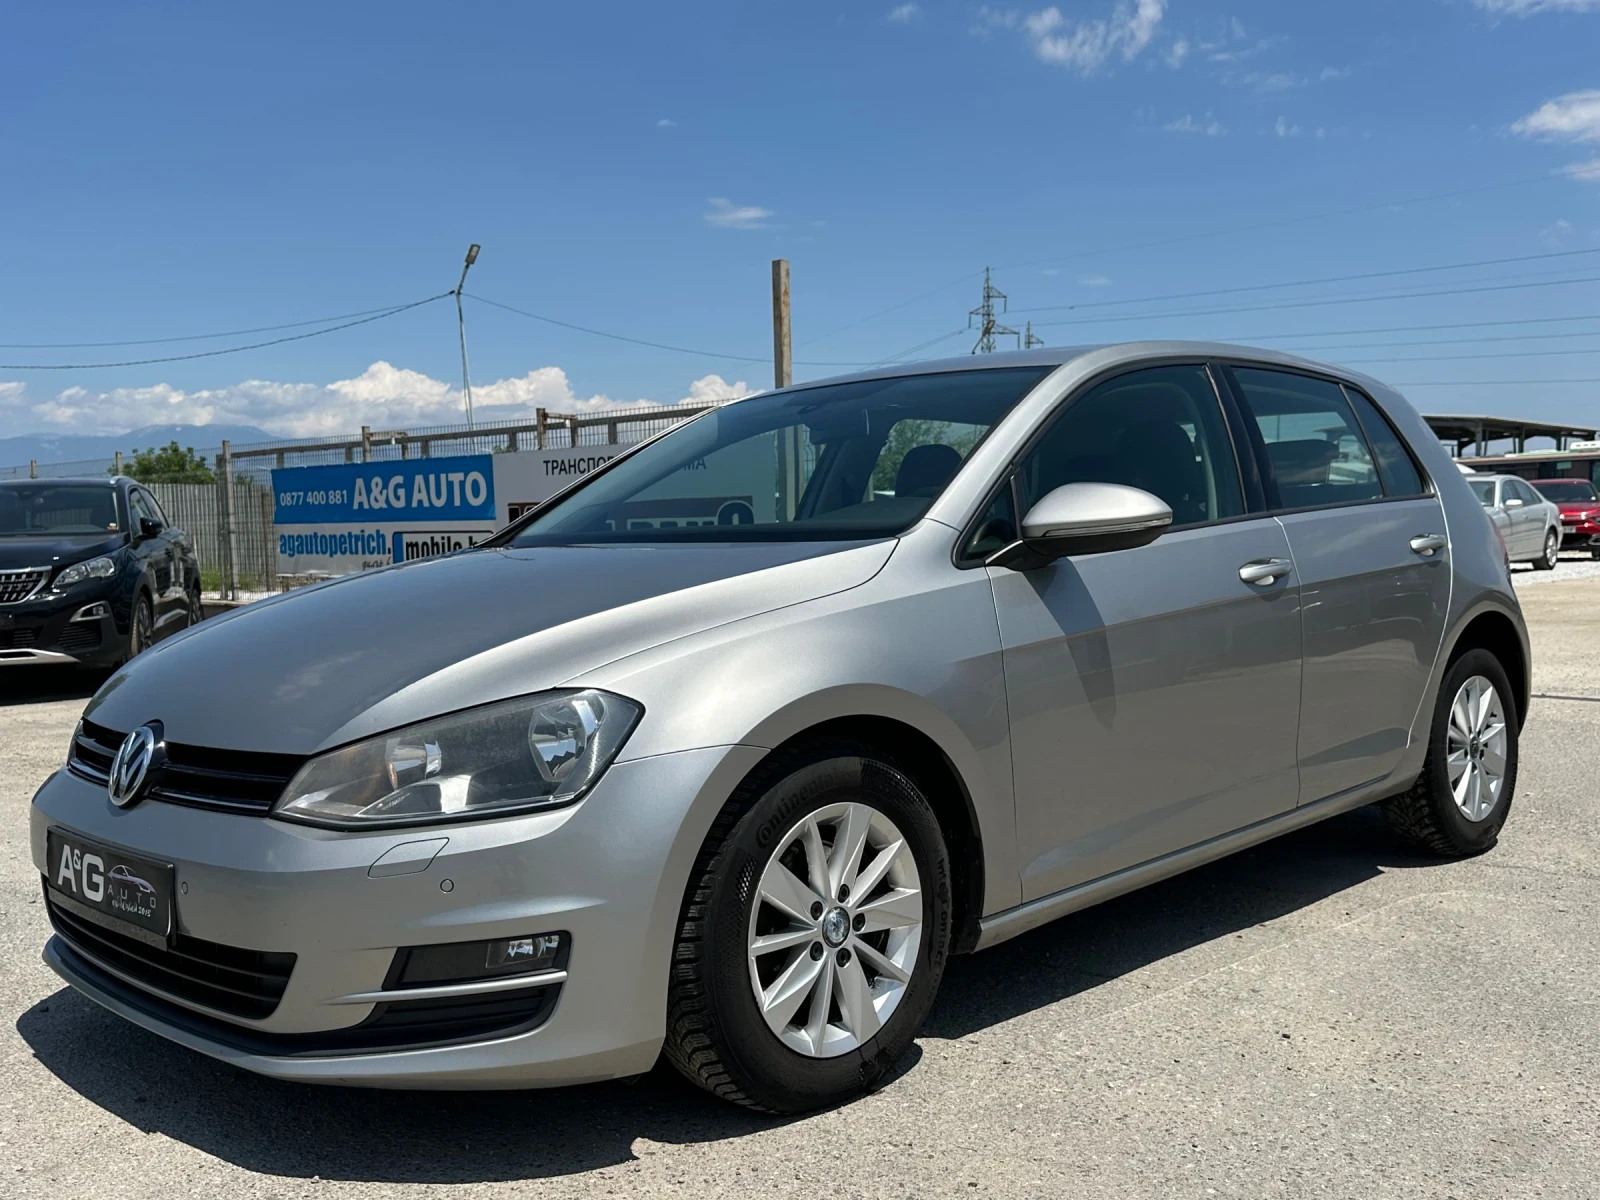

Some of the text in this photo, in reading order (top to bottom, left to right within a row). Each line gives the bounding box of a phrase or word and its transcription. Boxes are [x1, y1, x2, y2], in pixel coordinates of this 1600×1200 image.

[543, 456, 615, 476] ТРАНСПО
[280, 471, 487, 510] 0877 400 881 A&G AUTO
[57, 843, 105, 903] A&G
[107, 884, 157, 909] AUTO
